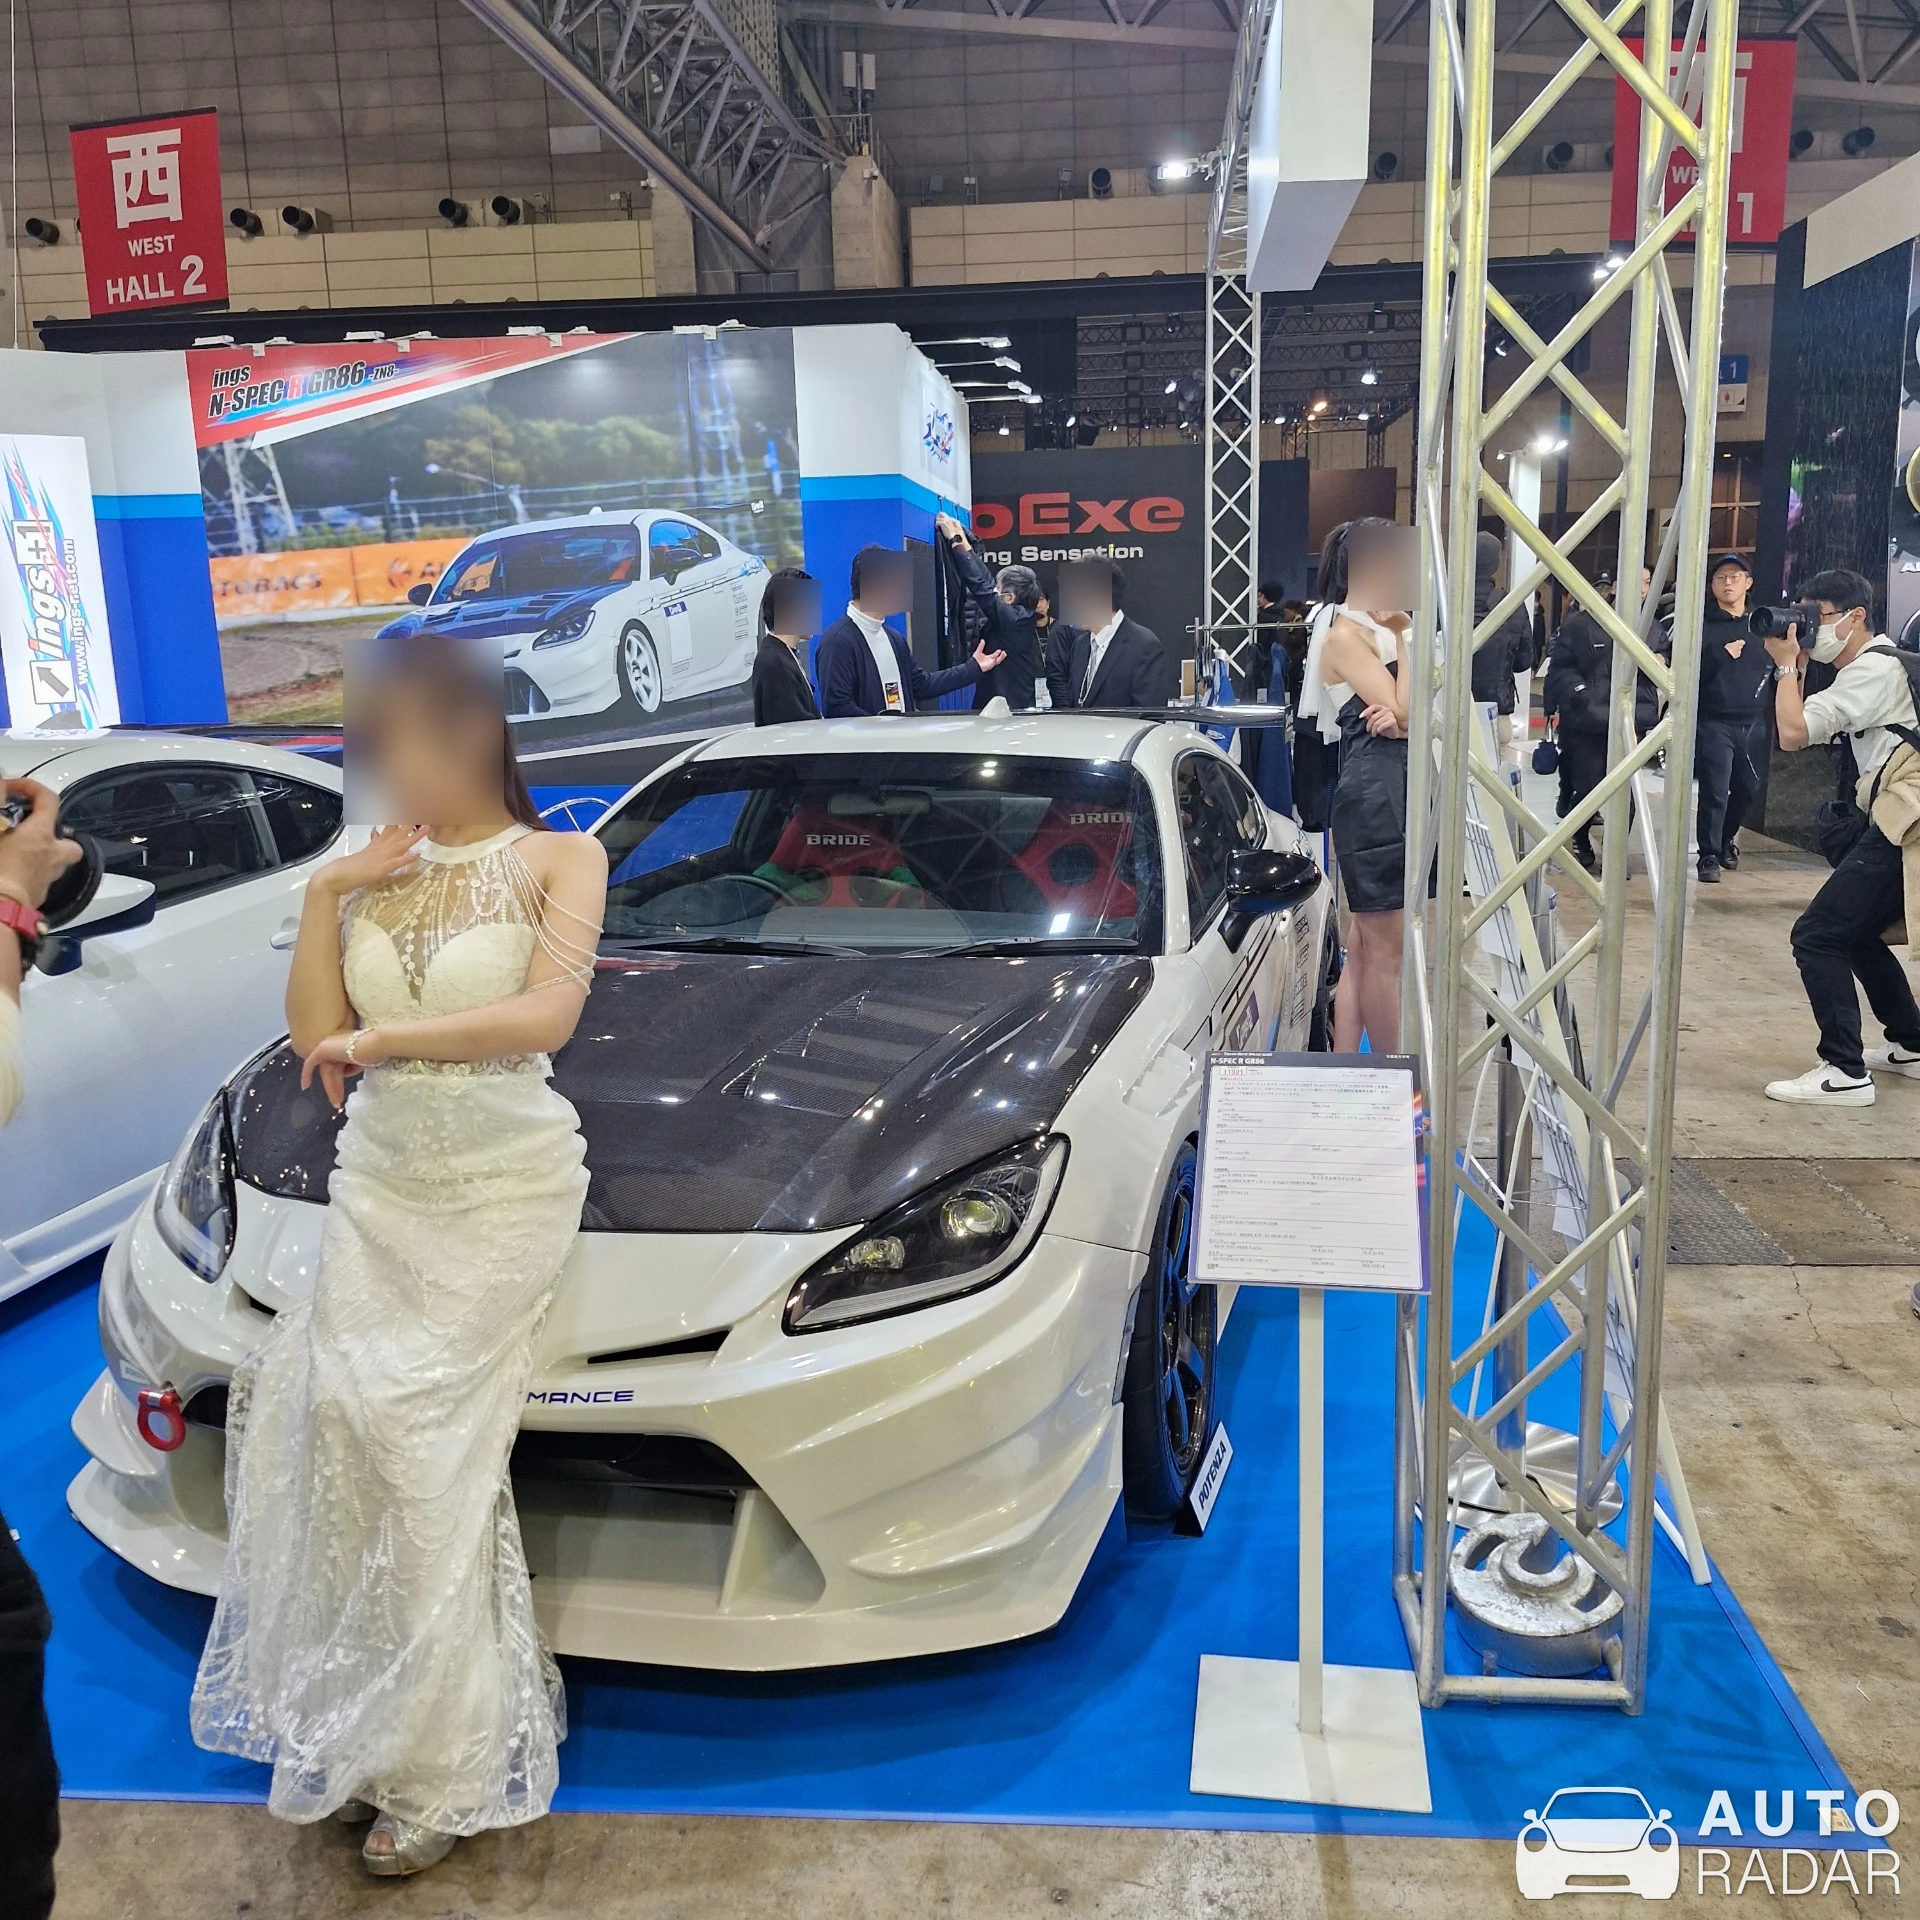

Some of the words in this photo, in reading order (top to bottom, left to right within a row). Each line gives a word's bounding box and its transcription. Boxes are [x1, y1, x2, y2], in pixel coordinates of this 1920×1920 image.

[106, 128, 183, 229] 西
[1671, 166, 1702, 184] WE
[1736, 192, 1754, 234] 1
[128, 234, 175, 257] WEST
[106, 272, 175, 305] HALL
[180, 254, 207, 296] 2
[212, 366, 251, 389] ings
[208, 380, 285, 418] N-SPEC
[287, 375, 305, 399] R
[307, 361, 366, 395] GR86
[1021, 543, 1144, 562] Sensation
[63, 538, 90, 686] www.ings-net.com
[805, 834, 871, 846] BRIDE
[1210, 1057, 1237, 1065] N-SPEC
[1244, 1057, 1265, 1065] GR86
[526, 1390, 635, 1404] MANCE
[1198, 1440, 1227, 1511] POTENZA
